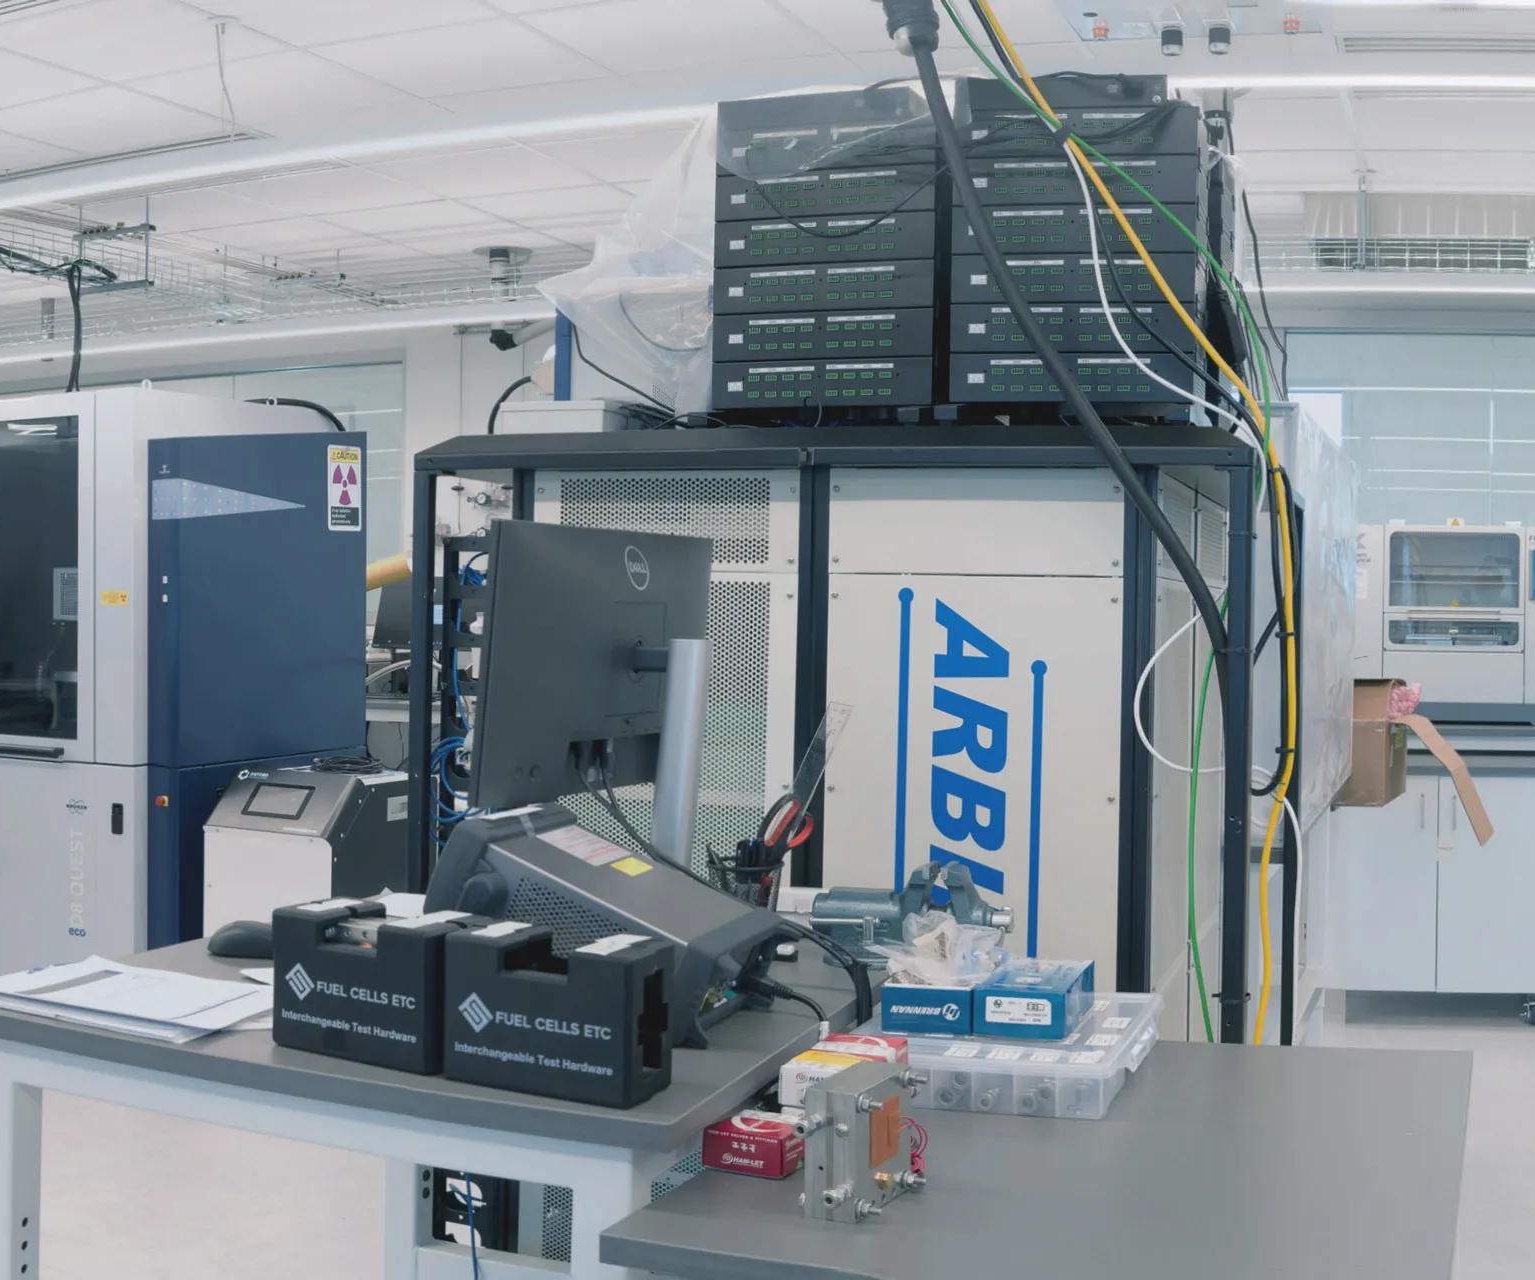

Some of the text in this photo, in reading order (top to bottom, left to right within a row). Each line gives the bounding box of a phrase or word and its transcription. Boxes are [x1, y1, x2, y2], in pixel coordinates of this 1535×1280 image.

[336, 452, 358, 460] CAUTION
[929, 597, 1010, 909] ARBI
[70, 827, 83, 897] QUEST
[68, 927, 86, 938] eco
[316, 981, 415, 1009] FUEL CELLS ETC
[890, 1004, 942, 1016] BRENNAN
[281, 1009, 417, 1043] Interchangeable Test Hardware
[495, 1011, 612, 1040] FUEL CELLS ETC
[454, 1041, 613, 1076] Interchangeable Test Hardware
[733, 1156, 765, 1166] HAM-LET
